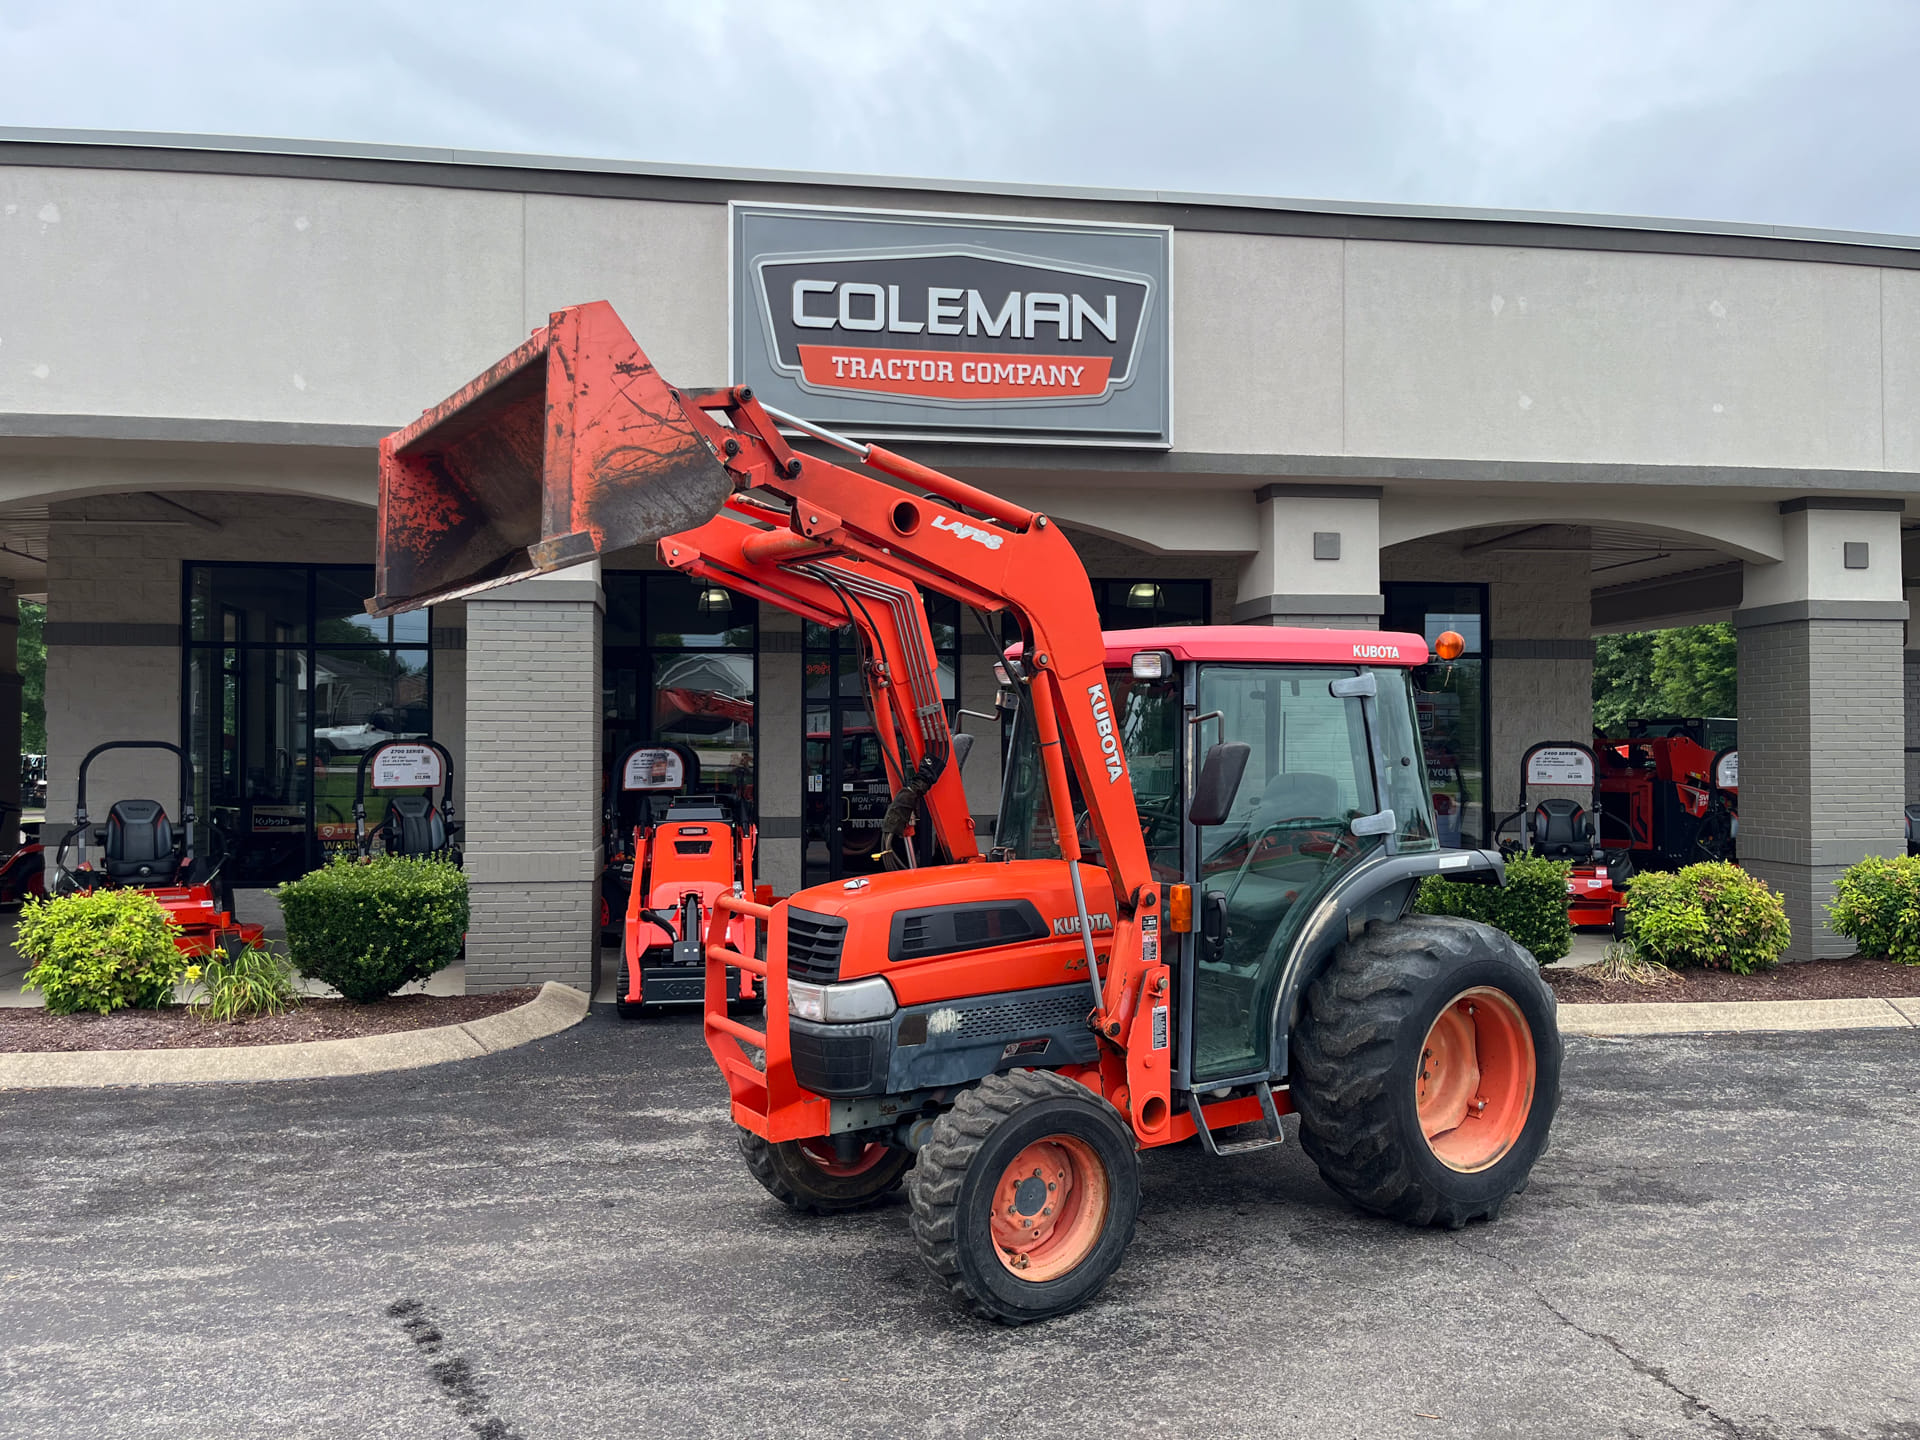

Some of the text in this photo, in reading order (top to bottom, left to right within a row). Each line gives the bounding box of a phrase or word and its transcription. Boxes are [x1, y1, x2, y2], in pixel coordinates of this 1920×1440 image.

[792, 279, 1117, 342] COLEMAN
[831, 356, 1085, 387] TRACTOR COMPANY
[1352, 644, 1400, 659] KUBOTA
[1087, 683, 1124, 785] KUBOTA
[868, 784, 890, 794] HOUR
